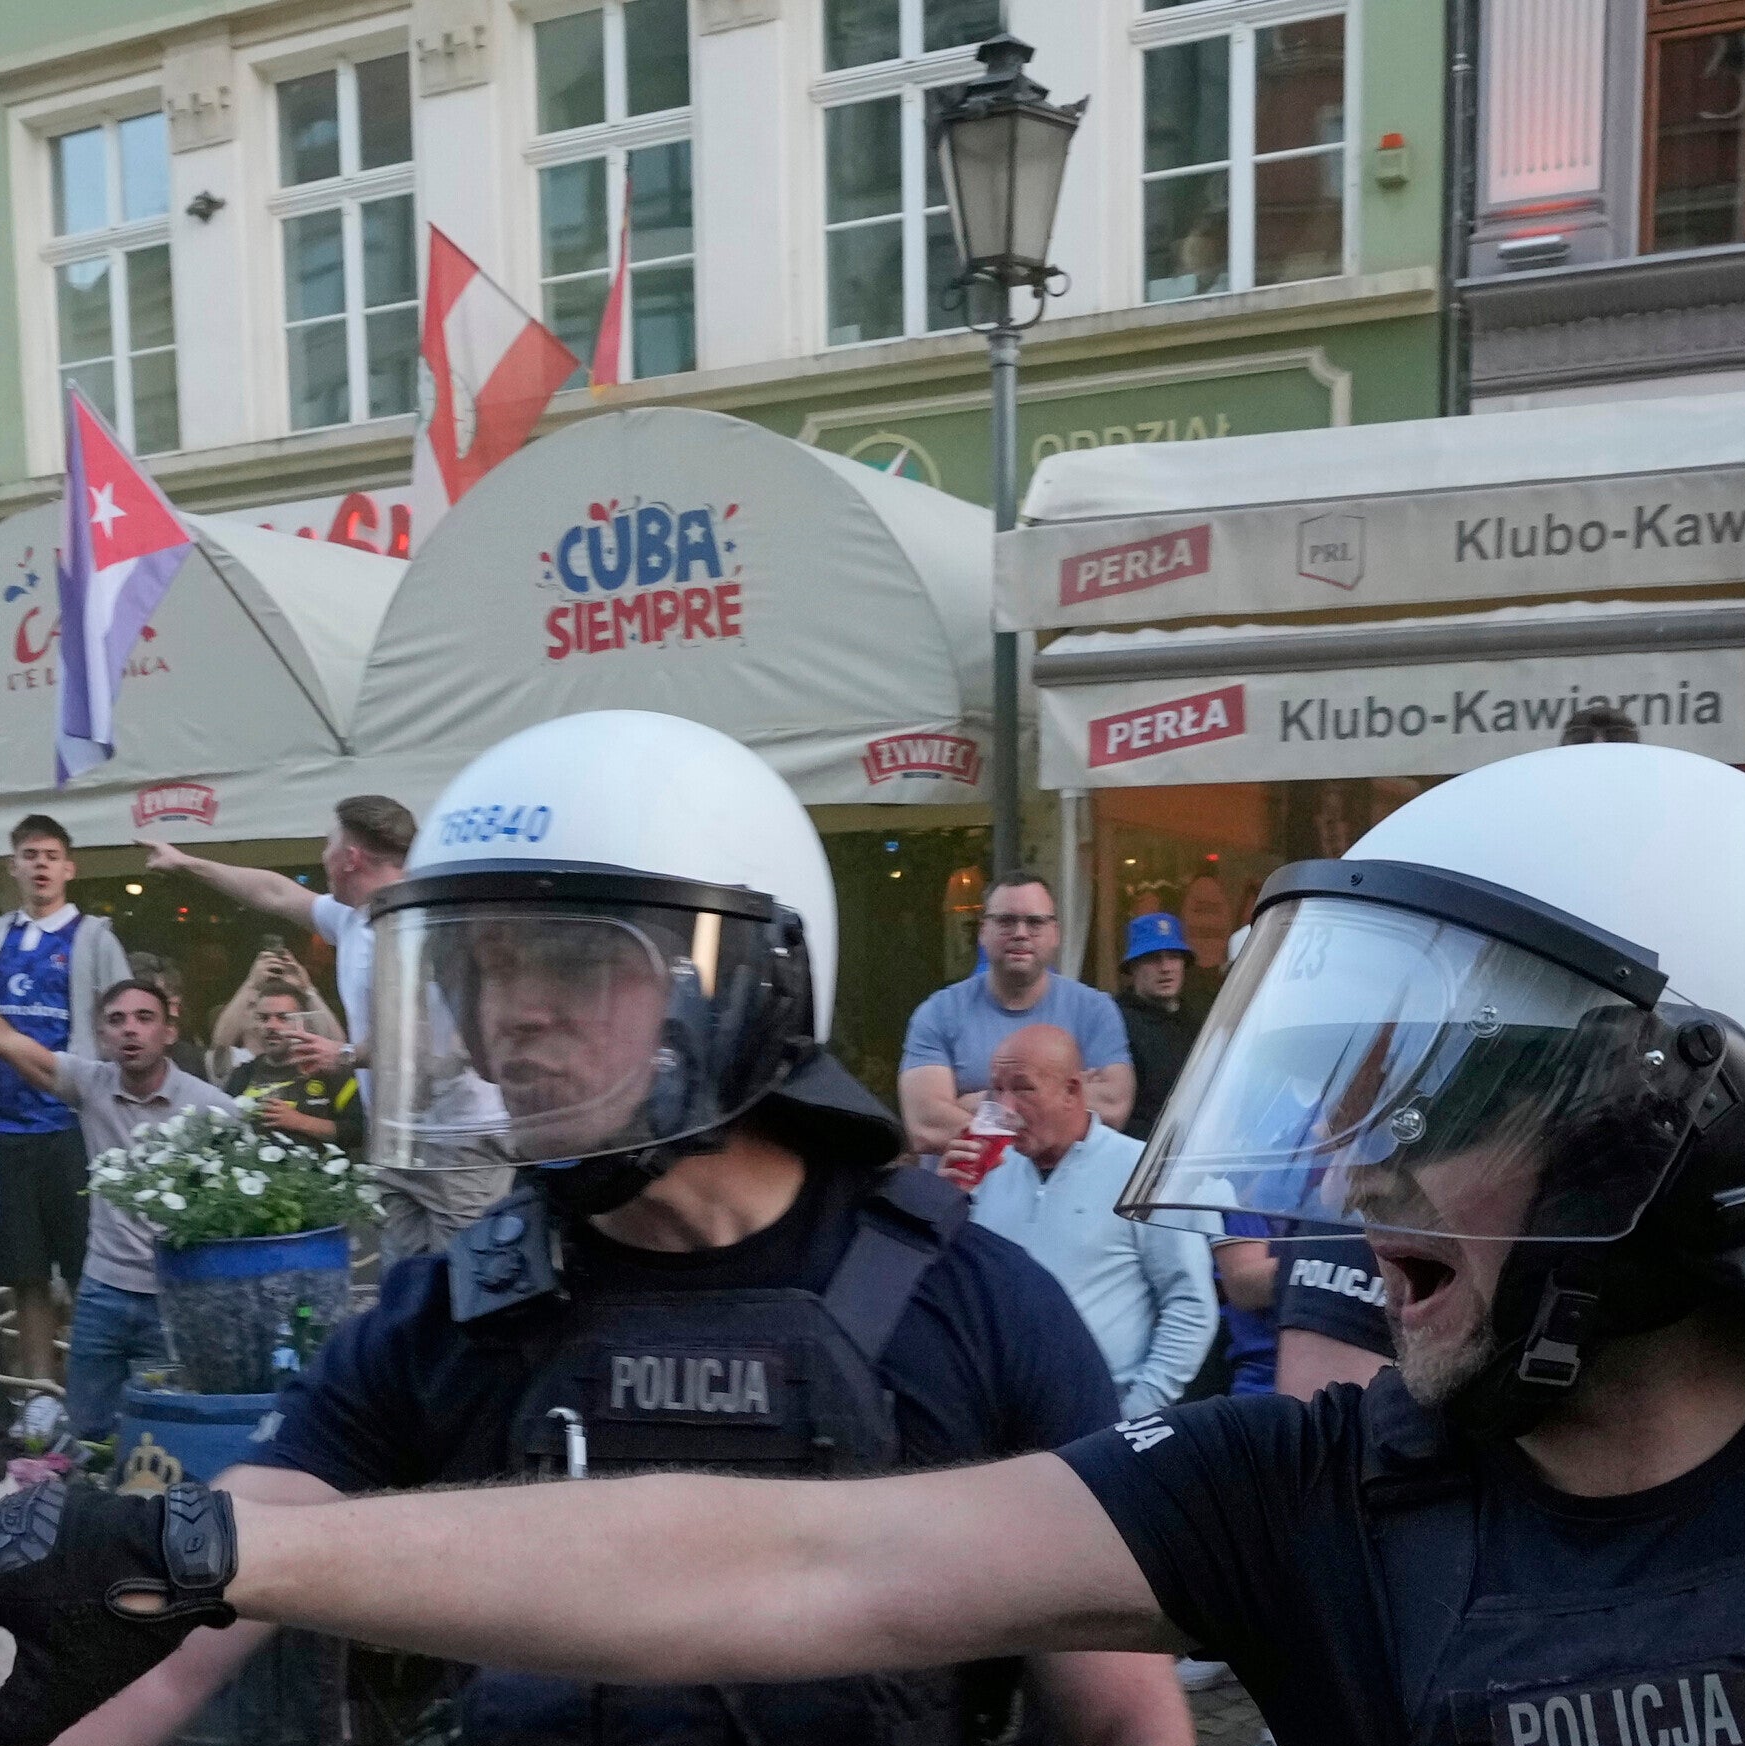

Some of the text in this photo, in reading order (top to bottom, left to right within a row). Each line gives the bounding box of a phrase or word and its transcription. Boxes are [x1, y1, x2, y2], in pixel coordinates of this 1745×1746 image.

[556, 507, 724, 593] CUBA
[1076, 544, 1194, 595] PERŁA
[545, 583, 742, 660] SIEMPRE
[1106, 697, 1230, 756] PERŁA
[611, 1355, 772, 1416] POLICJA
